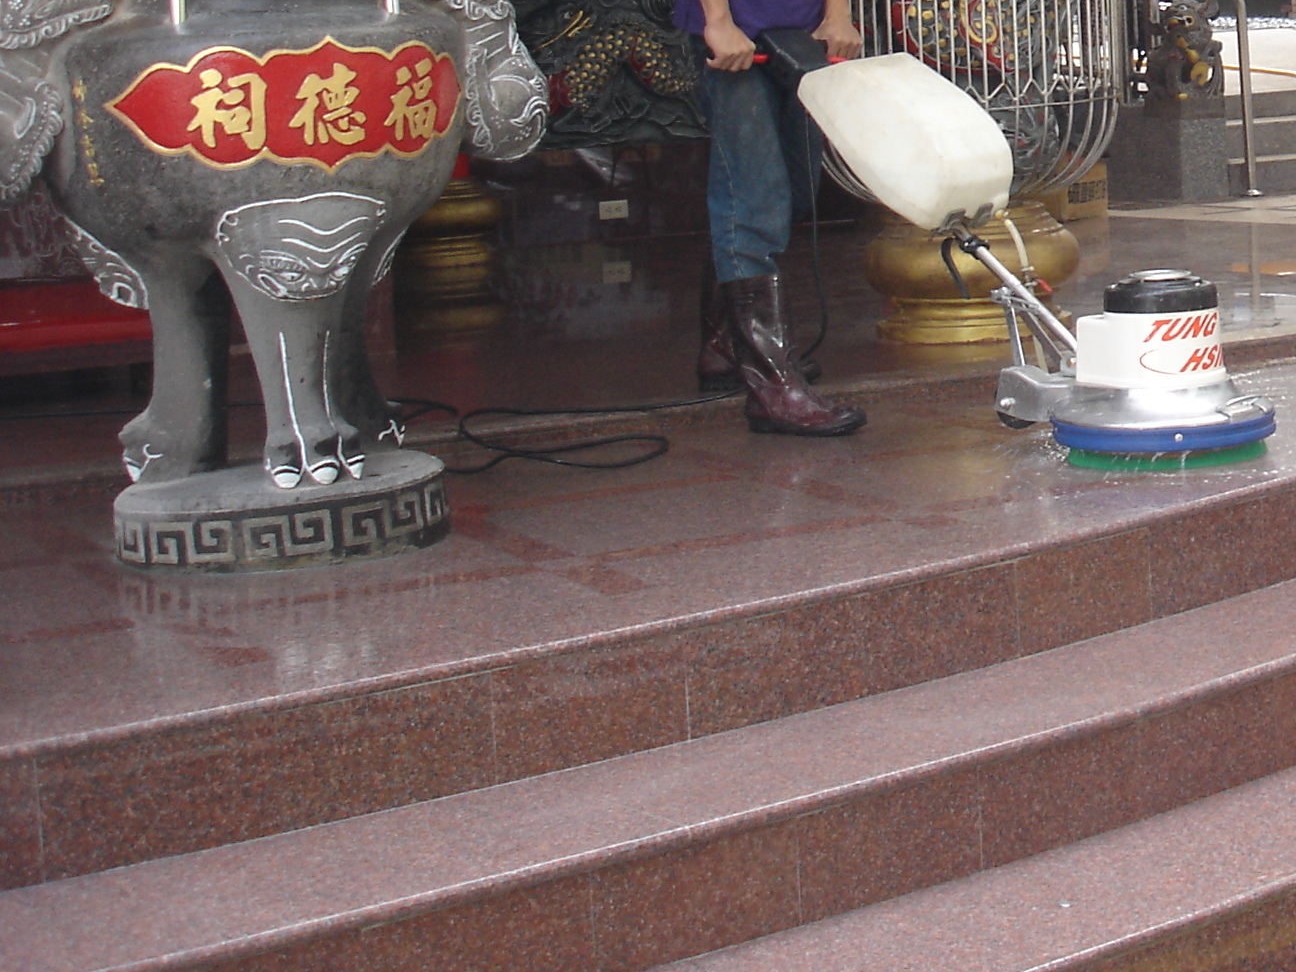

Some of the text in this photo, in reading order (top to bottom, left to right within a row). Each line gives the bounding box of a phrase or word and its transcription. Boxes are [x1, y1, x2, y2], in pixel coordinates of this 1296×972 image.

[187, 58, 437, 150] 福德祠
[1143, 312, 1218, 343] TUNG
